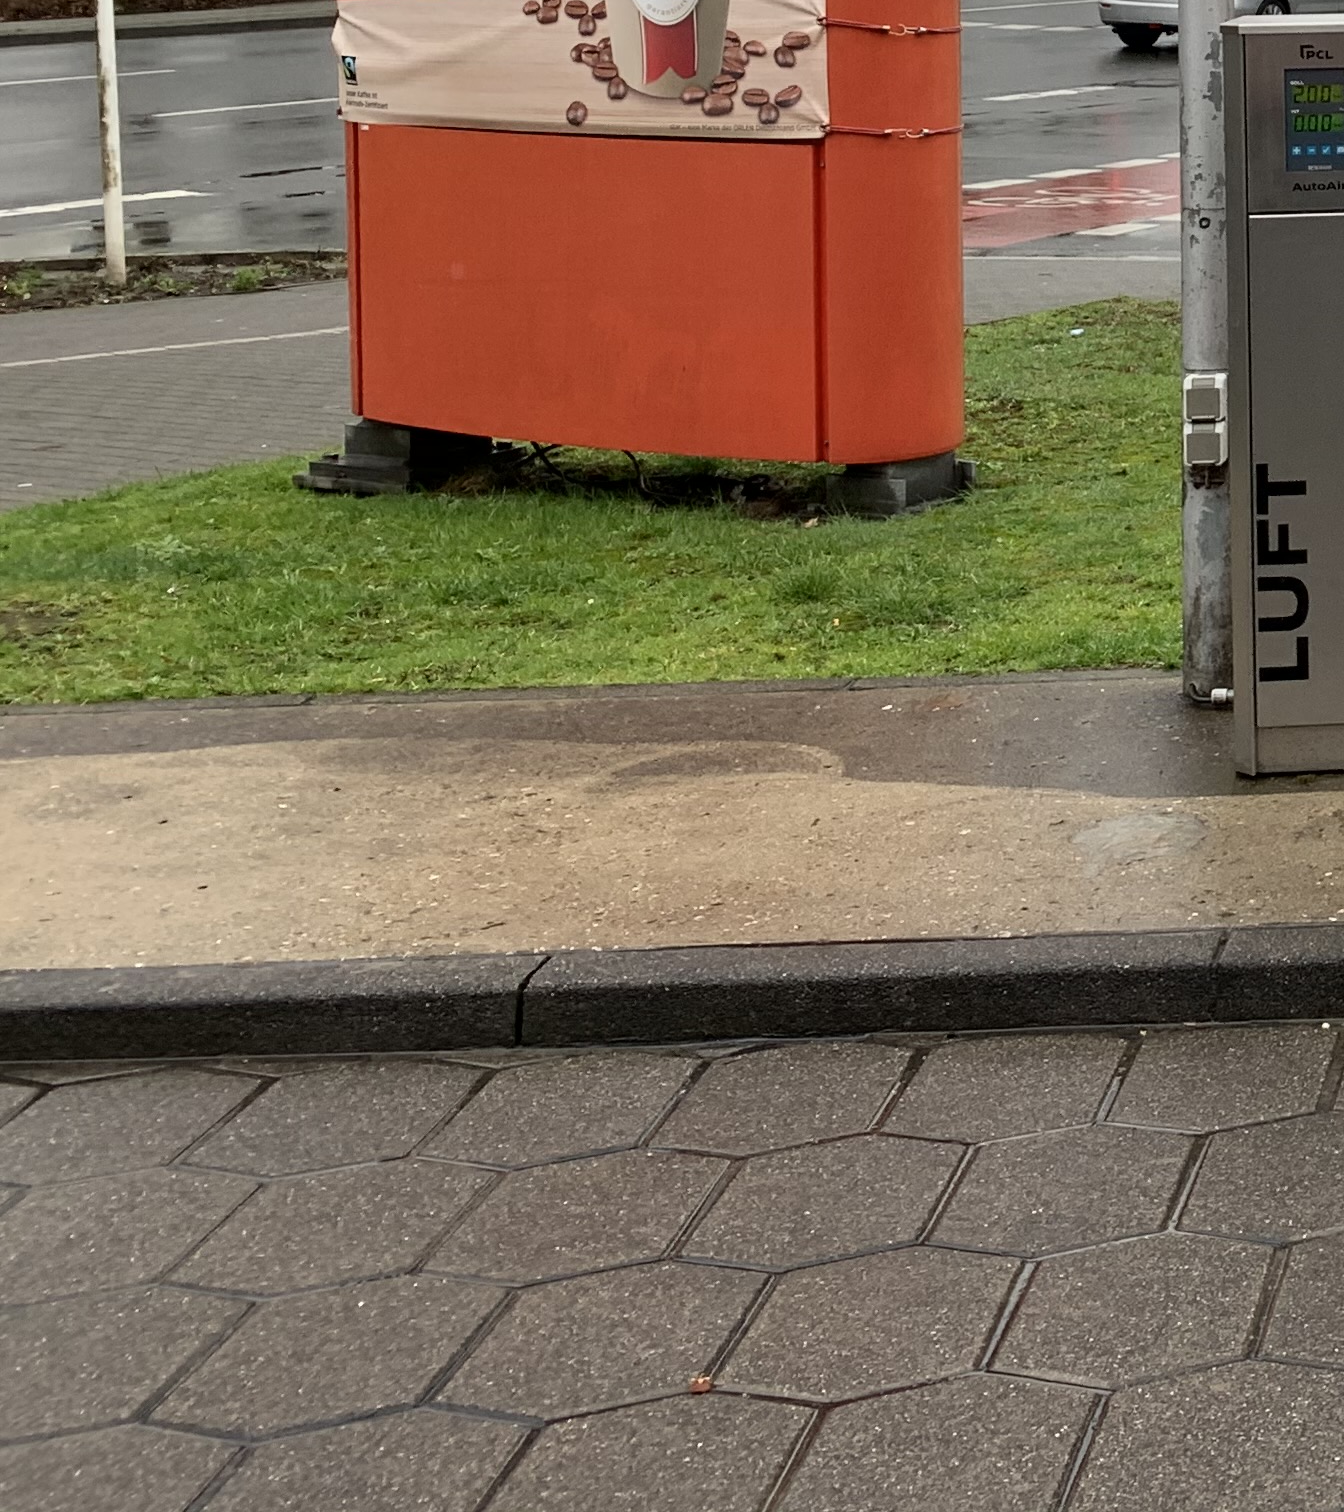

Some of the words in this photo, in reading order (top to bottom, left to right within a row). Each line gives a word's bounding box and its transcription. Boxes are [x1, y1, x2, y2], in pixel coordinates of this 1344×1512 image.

[1304, 49, 1334, 60] PCL
[1293, 84, 1332, 104] 2.00
[1293, 114, 1333, 133] 0.00
[1255, 462, 1310, 683] LUFT
